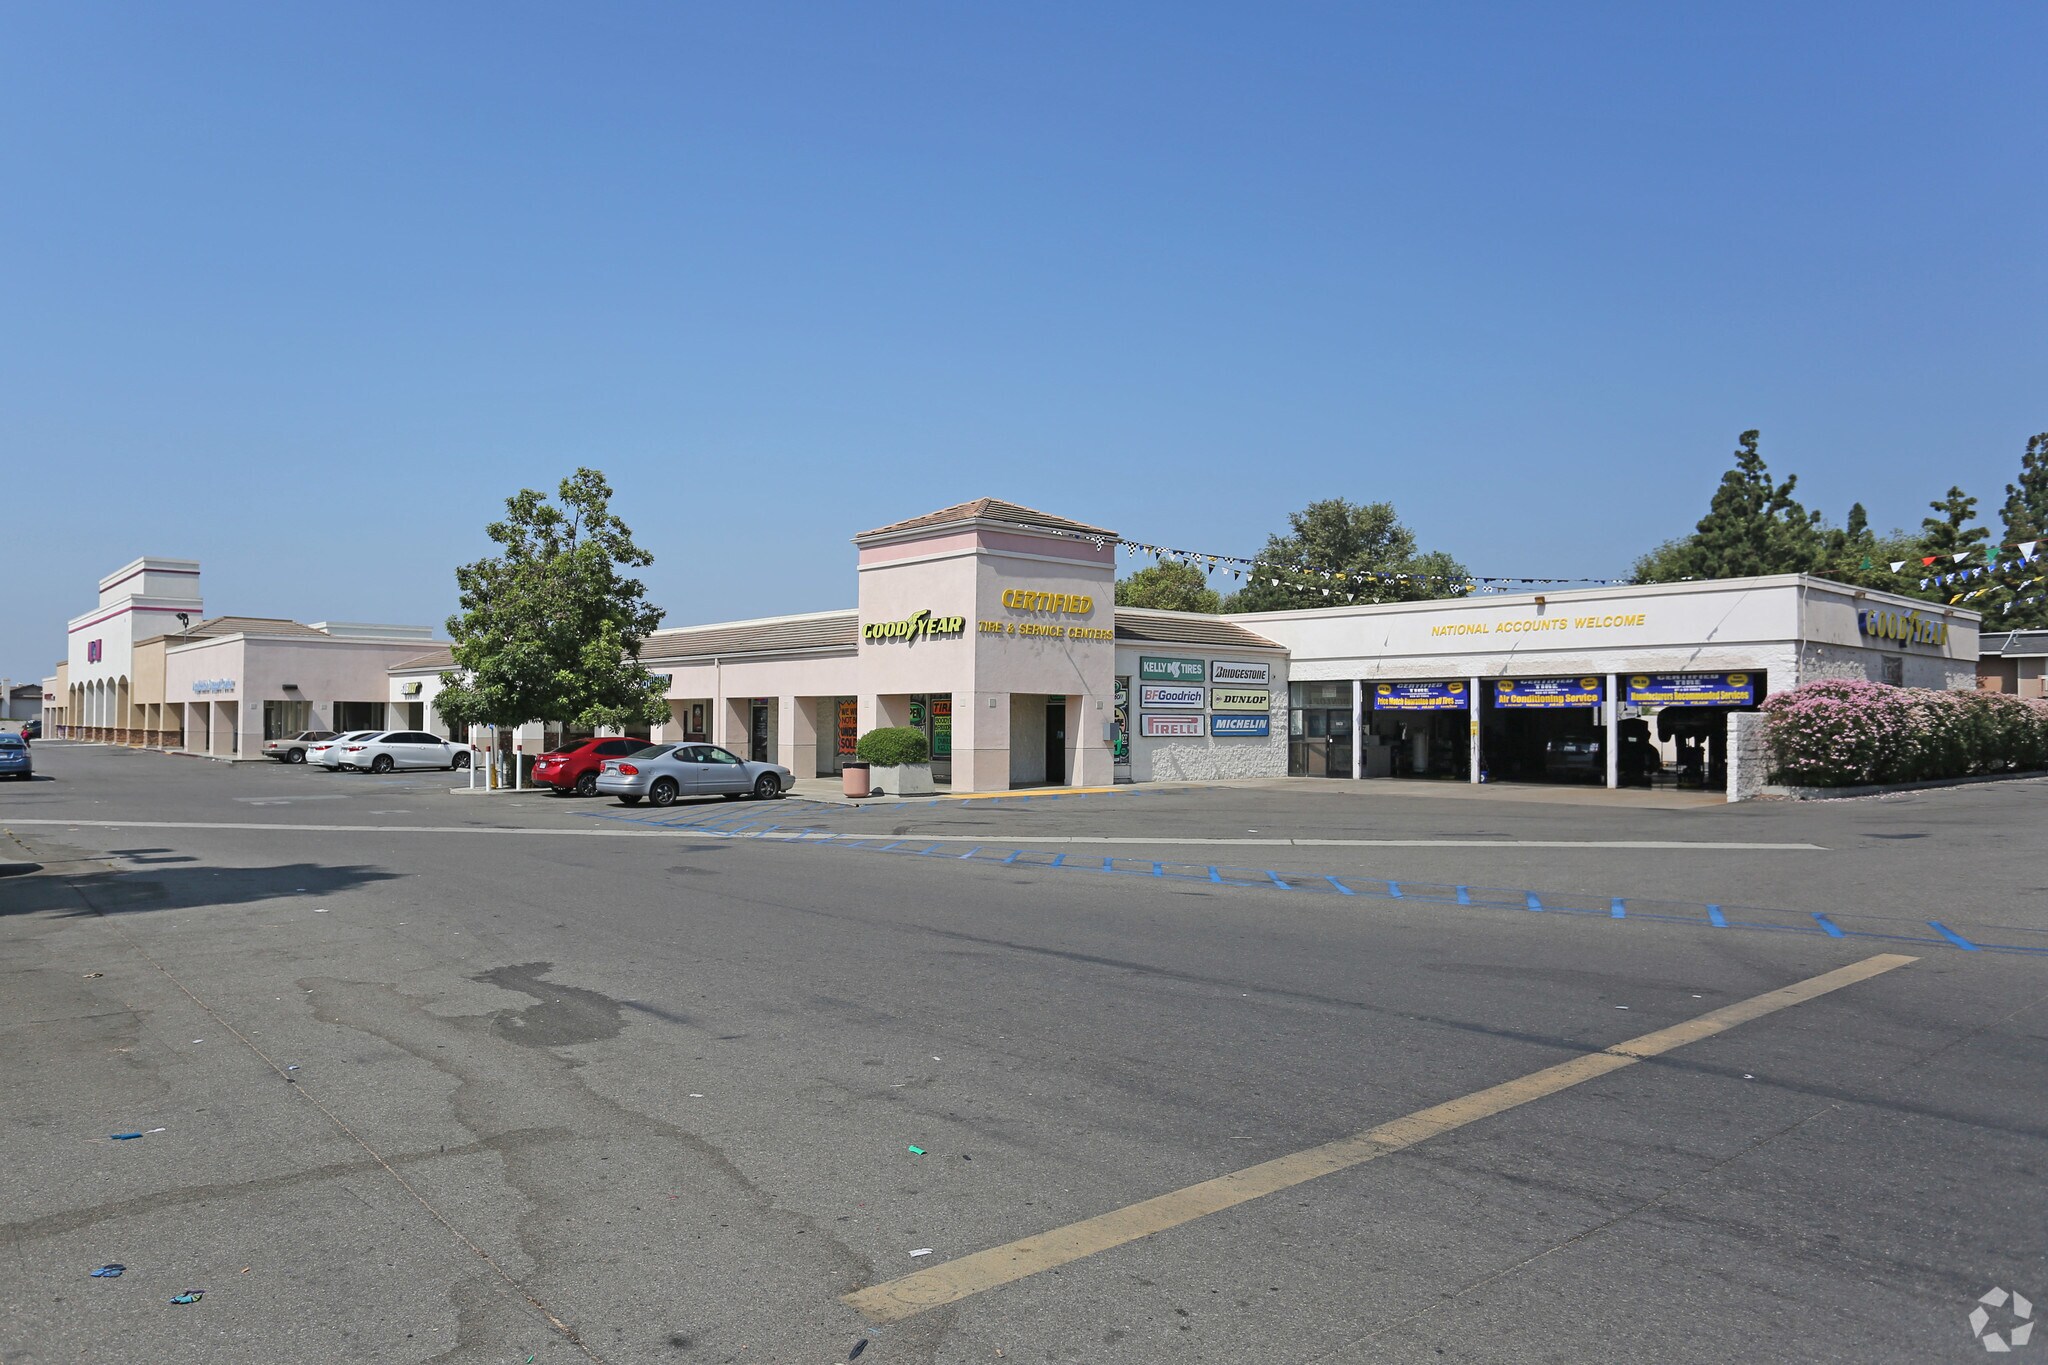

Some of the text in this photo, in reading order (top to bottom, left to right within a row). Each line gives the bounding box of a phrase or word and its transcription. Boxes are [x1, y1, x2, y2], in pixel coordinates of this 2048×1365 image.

[1002, 589, 1094, 614] CERTIFIED
[862, 609, 965, 641] GOODYEAR
[978, 621, 1113, 640] TIRE & SERVICE CENTERS
[1431, 614, 1646, 637] NATIONAL ACCOUNTS WELCOME
[1865, 609, 1948, 645] GOODYEAR
[1143, 661, 1167, 673] KELLY
[1181, 663, 1202, 674] TIRES
[1214, 666, 1266, 680] BRIDGESTONE
[1145, 689, 1201, 701] BFGoodrich
[1223, 695, 1266, 704] DUNLOP
[1499, 693, 1598, 703] Air Conditioning Service
[910, 707, 921, 719] PEN
[934, 702, 951, 713] TIR
[1147, 717, 1198, 734] PIRELLI
[1215, 719, 1267, 729] MICHELIN
[841, 727, 857, 736] UNDE
